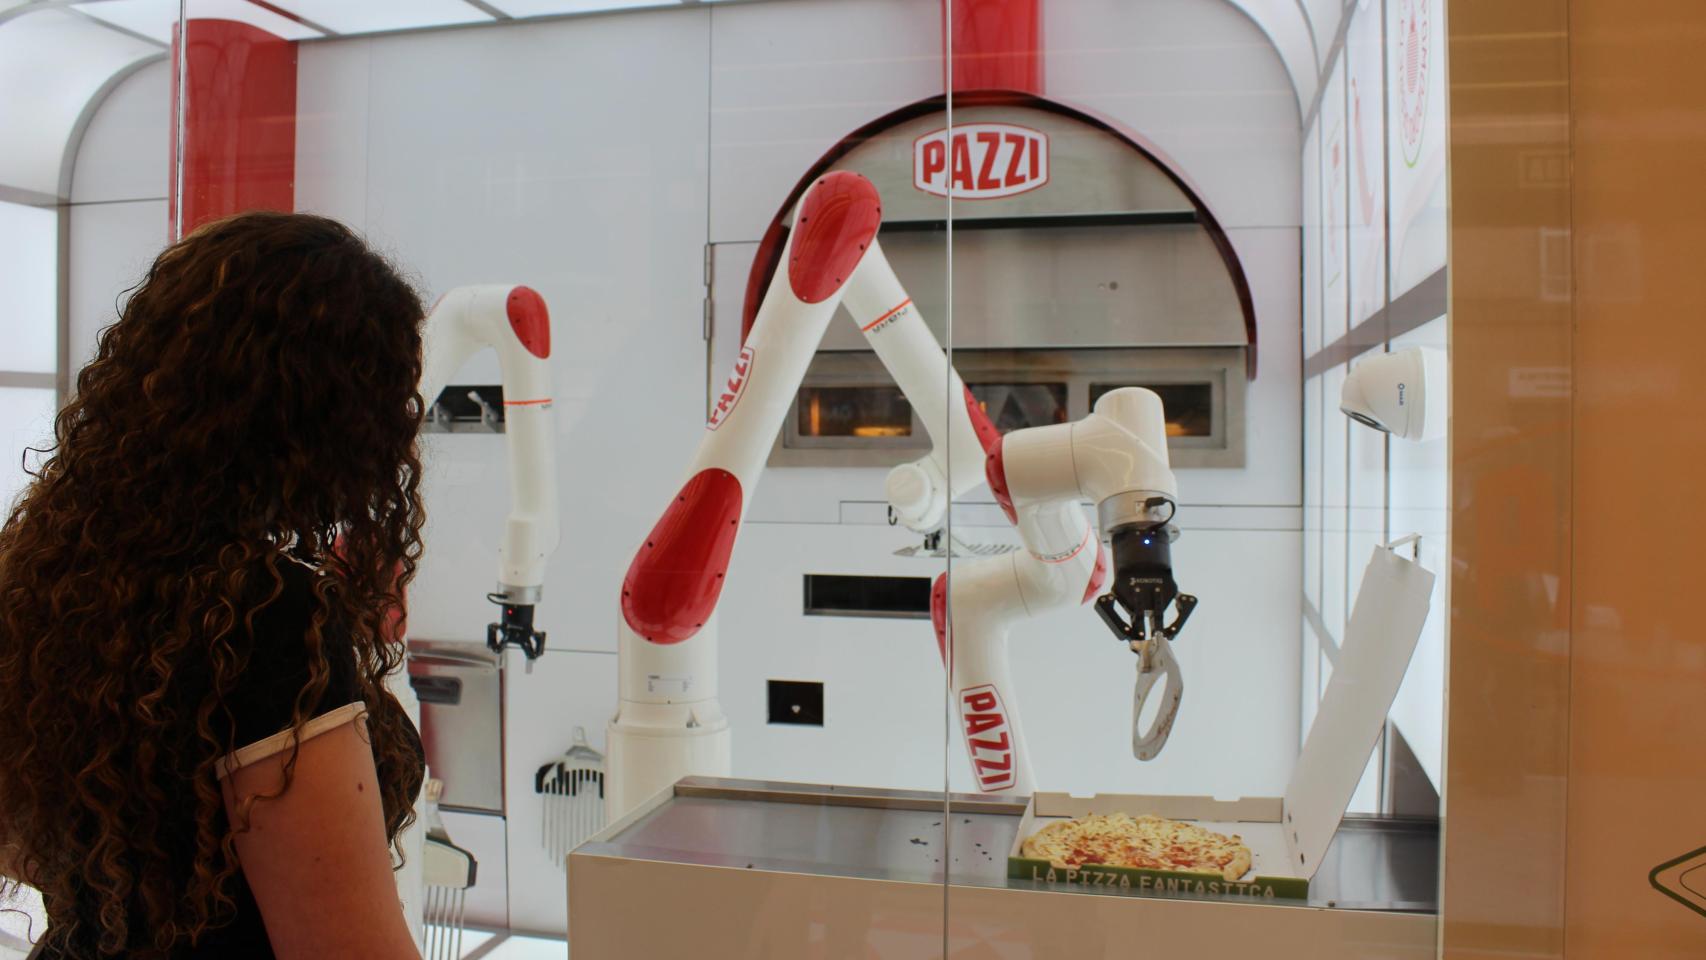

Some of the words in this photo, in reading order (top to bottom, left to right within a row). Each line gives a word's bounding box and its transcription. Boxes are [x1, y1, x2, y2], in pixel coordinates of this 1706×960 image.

[923, 132, 1039, 191] PAZZI
[963, 691, 1011, 785] PAZZI
[1032, 866, 1057, 884] LA
[1066, 869, 1131, 889] PIZZA
[1140, 875, 1275, 898] FANTASTICA
